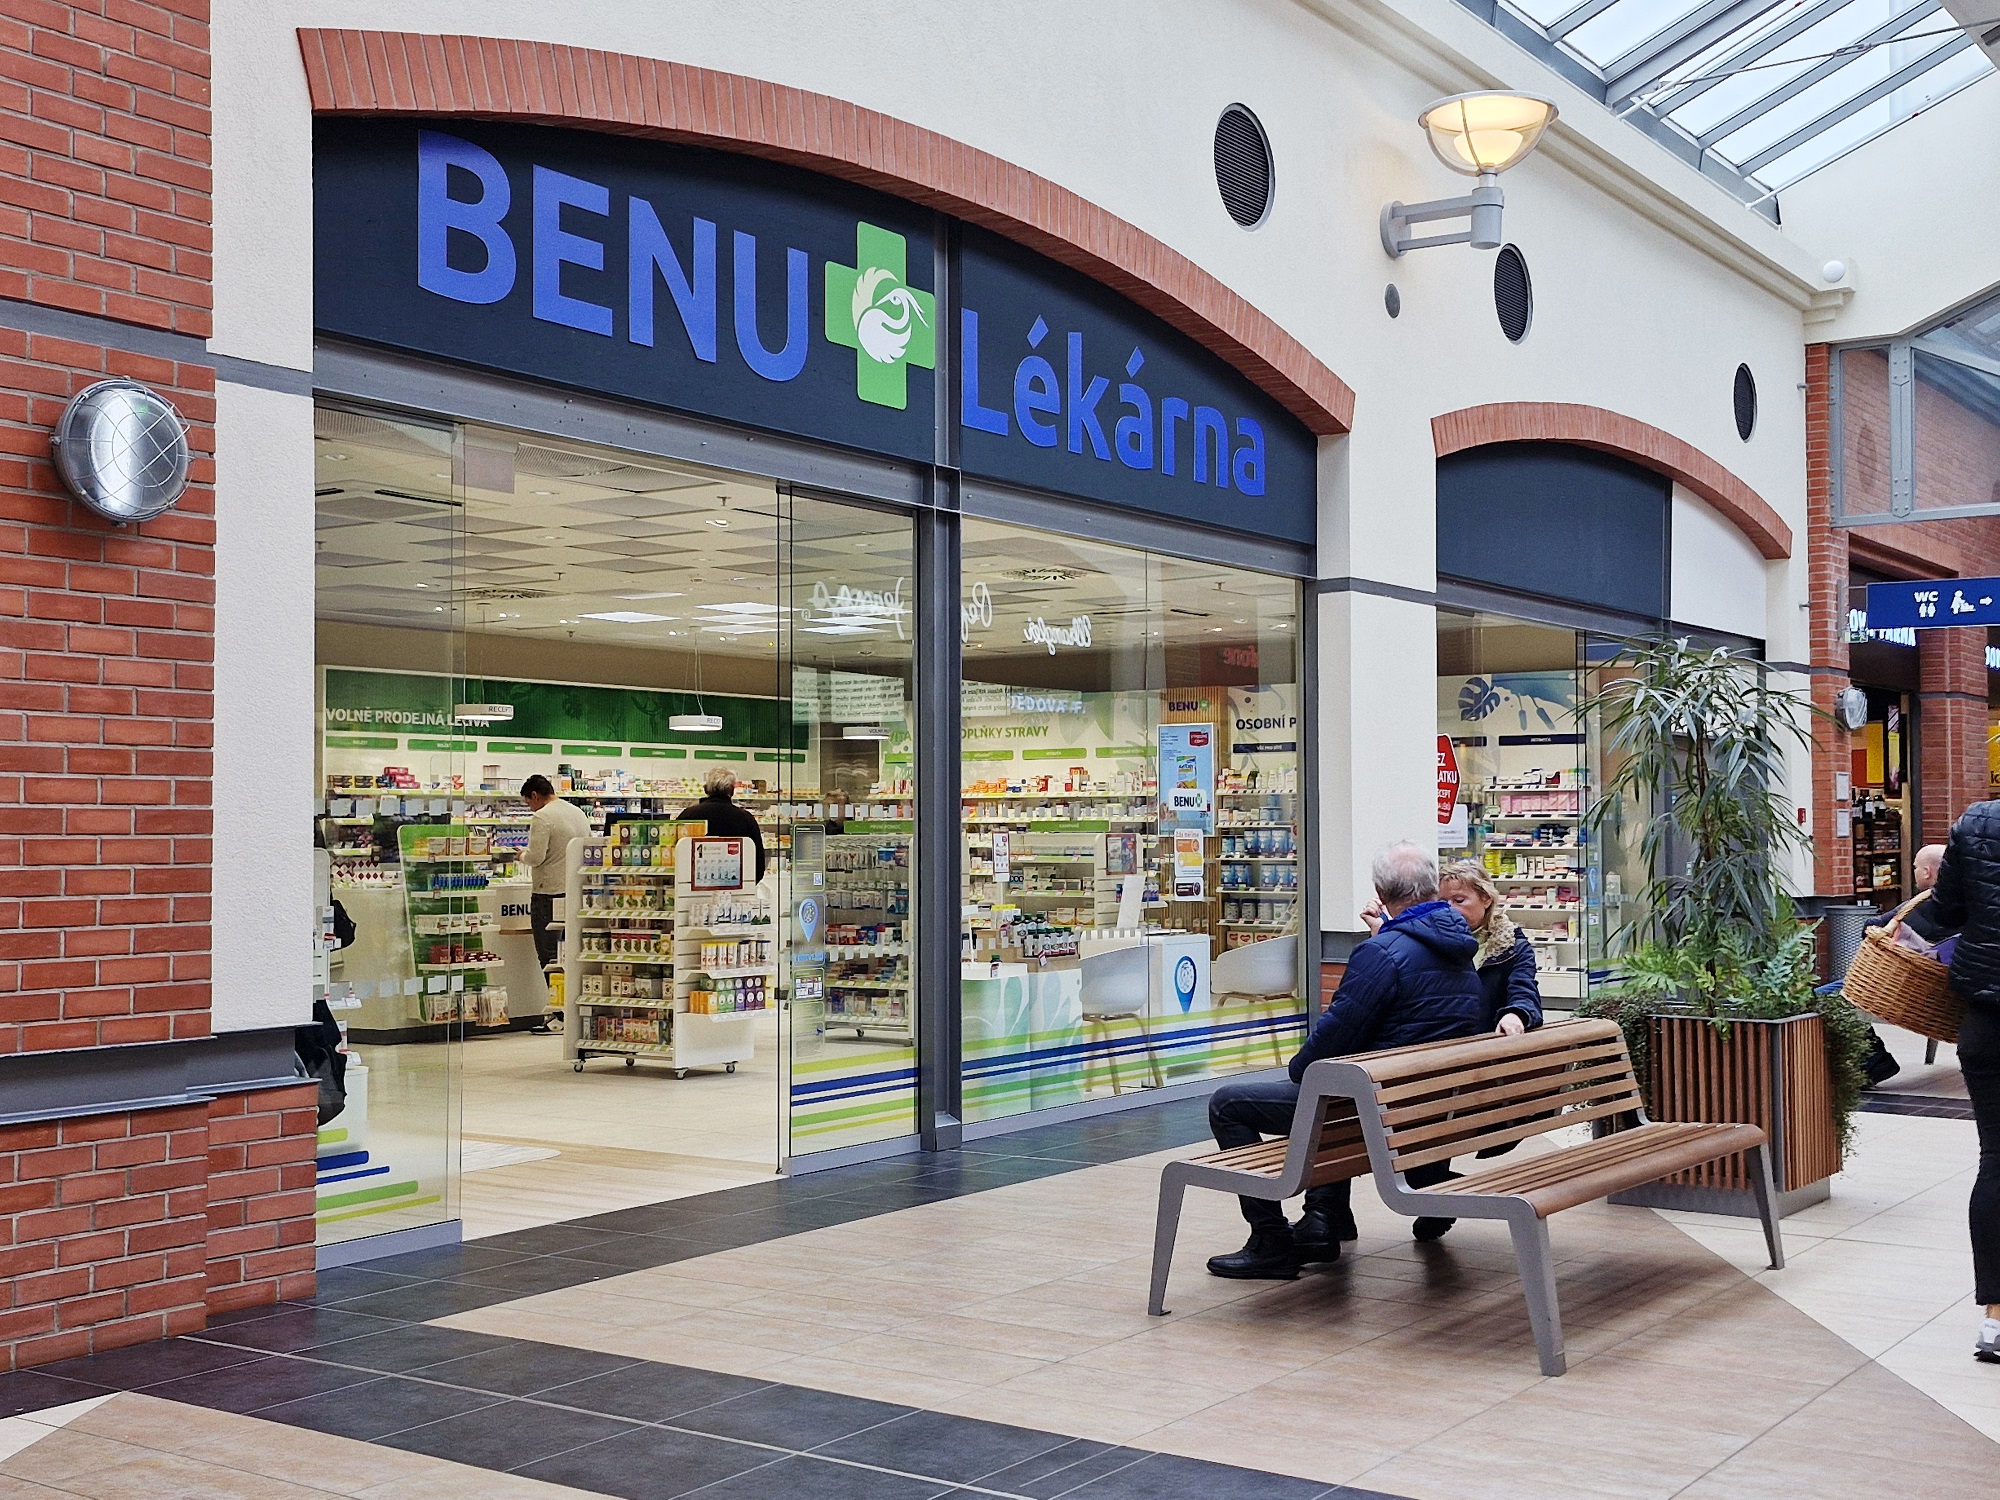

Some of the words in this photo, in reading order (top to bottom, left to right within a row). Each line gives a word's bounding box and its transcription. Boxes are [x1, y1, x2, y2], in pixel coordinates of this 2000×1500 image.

[418, 129, 809, 382] BENU
[961, 308, 1266, 497] Lékárna
[1914, 590, 1939, 603] WC
[1168, 701, 1198, 711] BENU
[326, 705, 372, 723] VOLNĚ
[375, 709, 446, 727] PRODEJNÁ
[1236, 714, 1285, 731] OSOBNÍ
[1004, 725, 1049, 739] STRAVY
[1174, 796, 1194, 807] BENU
[501, 904, 532, 917] BENU
